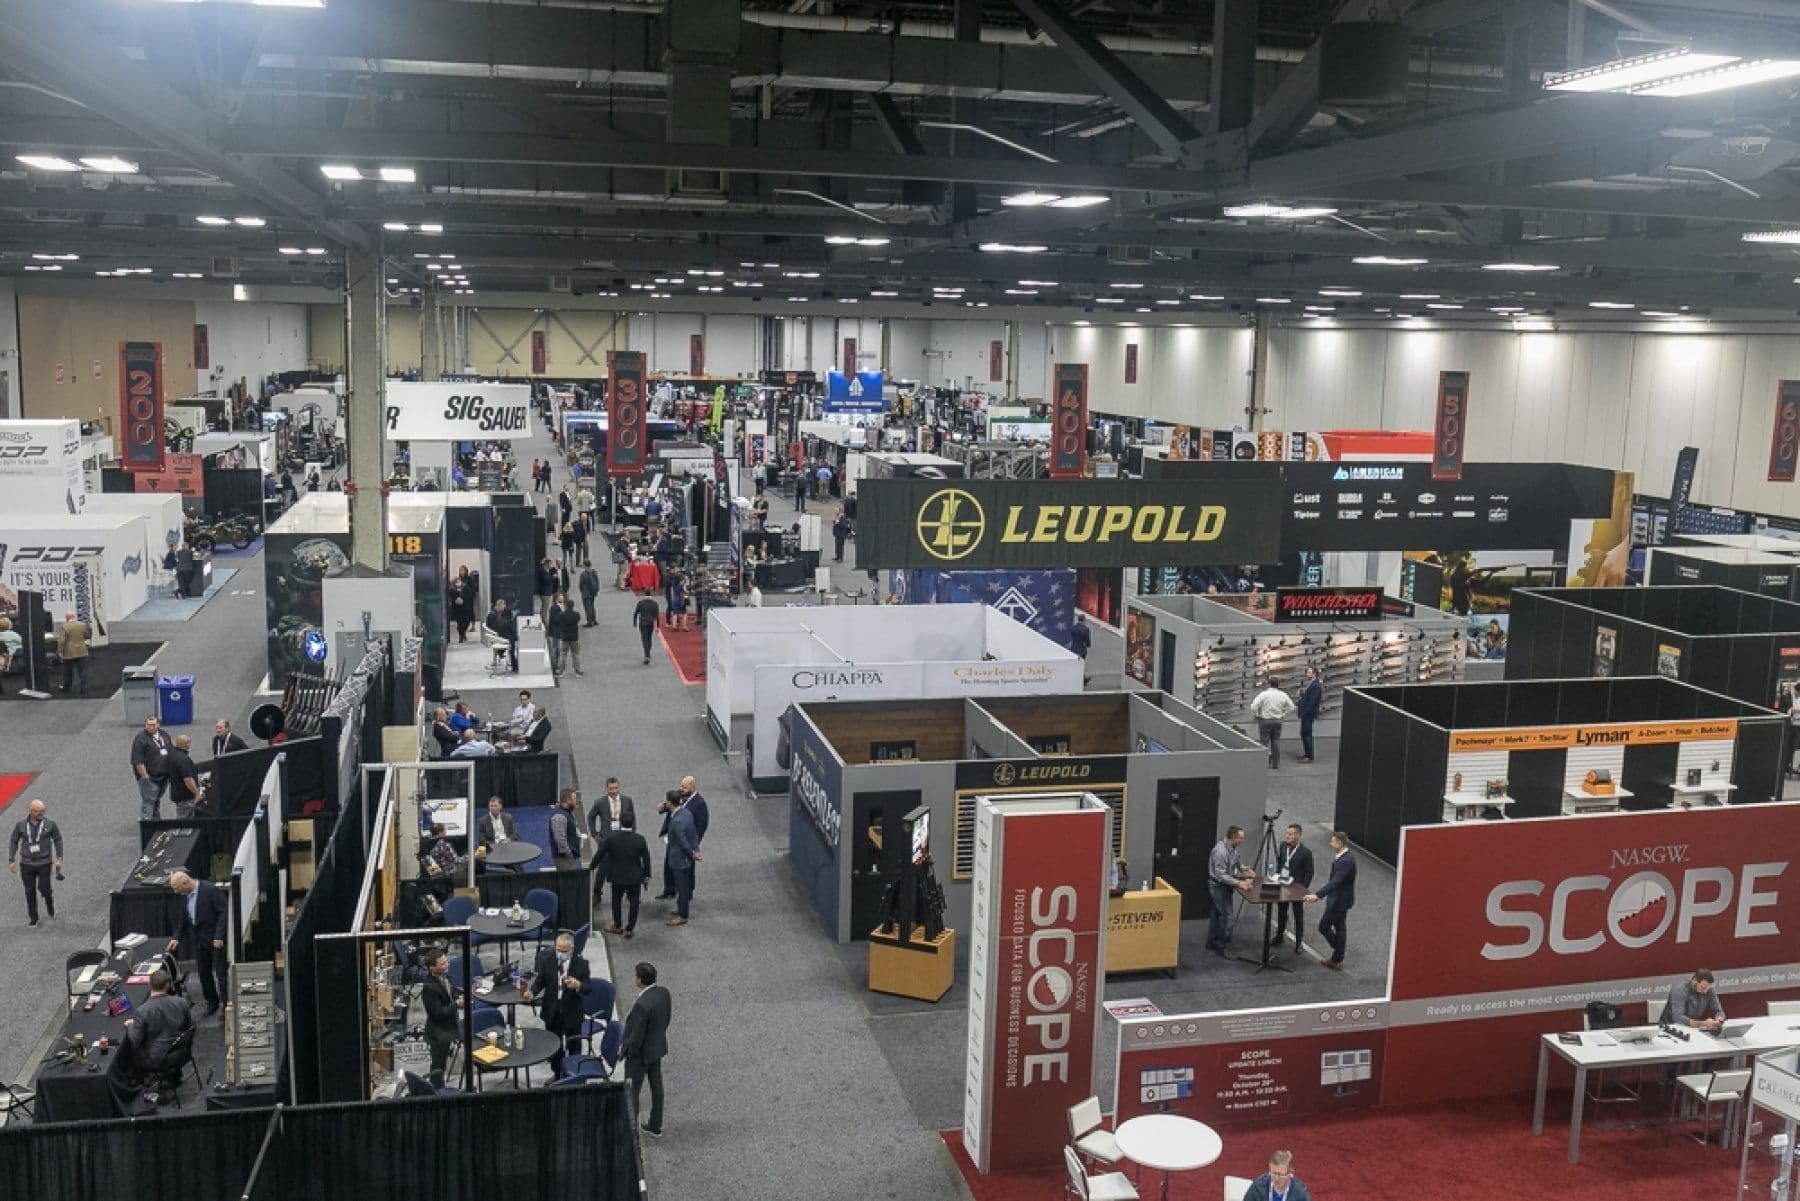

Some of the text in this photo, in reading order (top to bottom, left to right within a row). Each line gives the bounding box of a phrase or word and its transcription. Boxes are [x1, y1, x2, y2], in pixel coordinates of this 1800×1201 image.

[129, 370, 154, 446] 200
[444, 395, 485, 420] SIG
[479, 406, 527, 431] SAUER
[617, 379, 639, 449] 300
[1061, 388, 1079, 455] 400
[1001, 505, 1227, 543] LEUPOLD
[12, 546, 105, 562] PDP
[10, 572, 71, 586] IT'S YOUR
[1283, 592, 1378, 609] WINCHESTER
[792, 671, 882, 688] CHIAPPA
[953, 665, 1055, 678] Charles Daly
[1576, 729, 1630, 746] Lyman
[1020, 765, 1090, 779] LEUPOLD
[1609, 844, 1688, 868] NASGW
[1480, 861, 1790, 960] SCOPE
[1006, 889, 1026, 1087] FOCUSED DATA FOR BUSINESS DECISIONS
[1024, 885, 1077, 1088] SCOPE
[1074, 962, 1088, 1013] NASGW
[1426, 1005, 1458, 1016] Ready
[1461, 1004, 1471, 1012] to
[1474, 1001, 1506, 1010] access
[1510, 998, 1525, 1007] the
[1528, 996, 1552, 1006] most
[1554, 988, 1626, 1004] comprehensive
[1629, 987, 1651, 996] sales
[1228, 1058, 1282, 1068] UPDATE LUNCH
[1241, 1049, 1271, 1060] SCOPE
[1232, 1081, 1260, 1089] October
